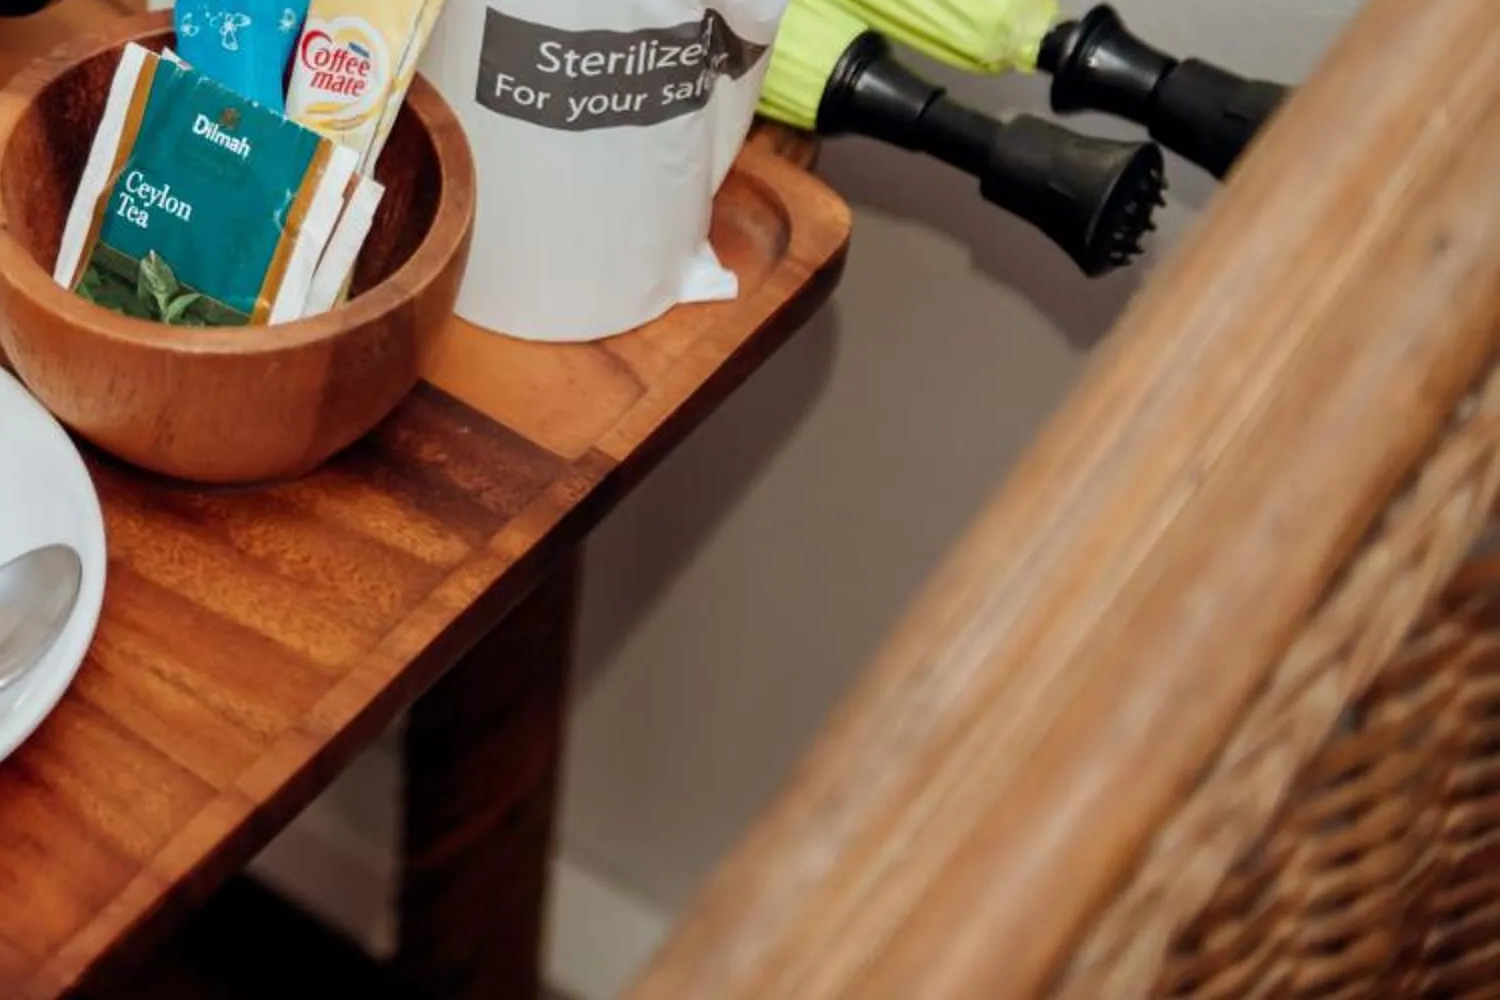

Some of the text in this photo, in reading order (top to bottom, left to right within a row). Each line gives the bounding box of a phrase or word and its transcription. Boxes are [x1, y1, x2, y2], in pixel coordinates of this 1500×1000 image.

[301, 28, 371, 77] Coffee
[309, 71, 366, 97] mate
[494, 72, 550, 110] For
[565, 92, 649, 123] your
[191, 112, 251, 159] Dilmah
[116, 191, 150, 229] Tea
[125, 170, 193, 222] Ceylon
